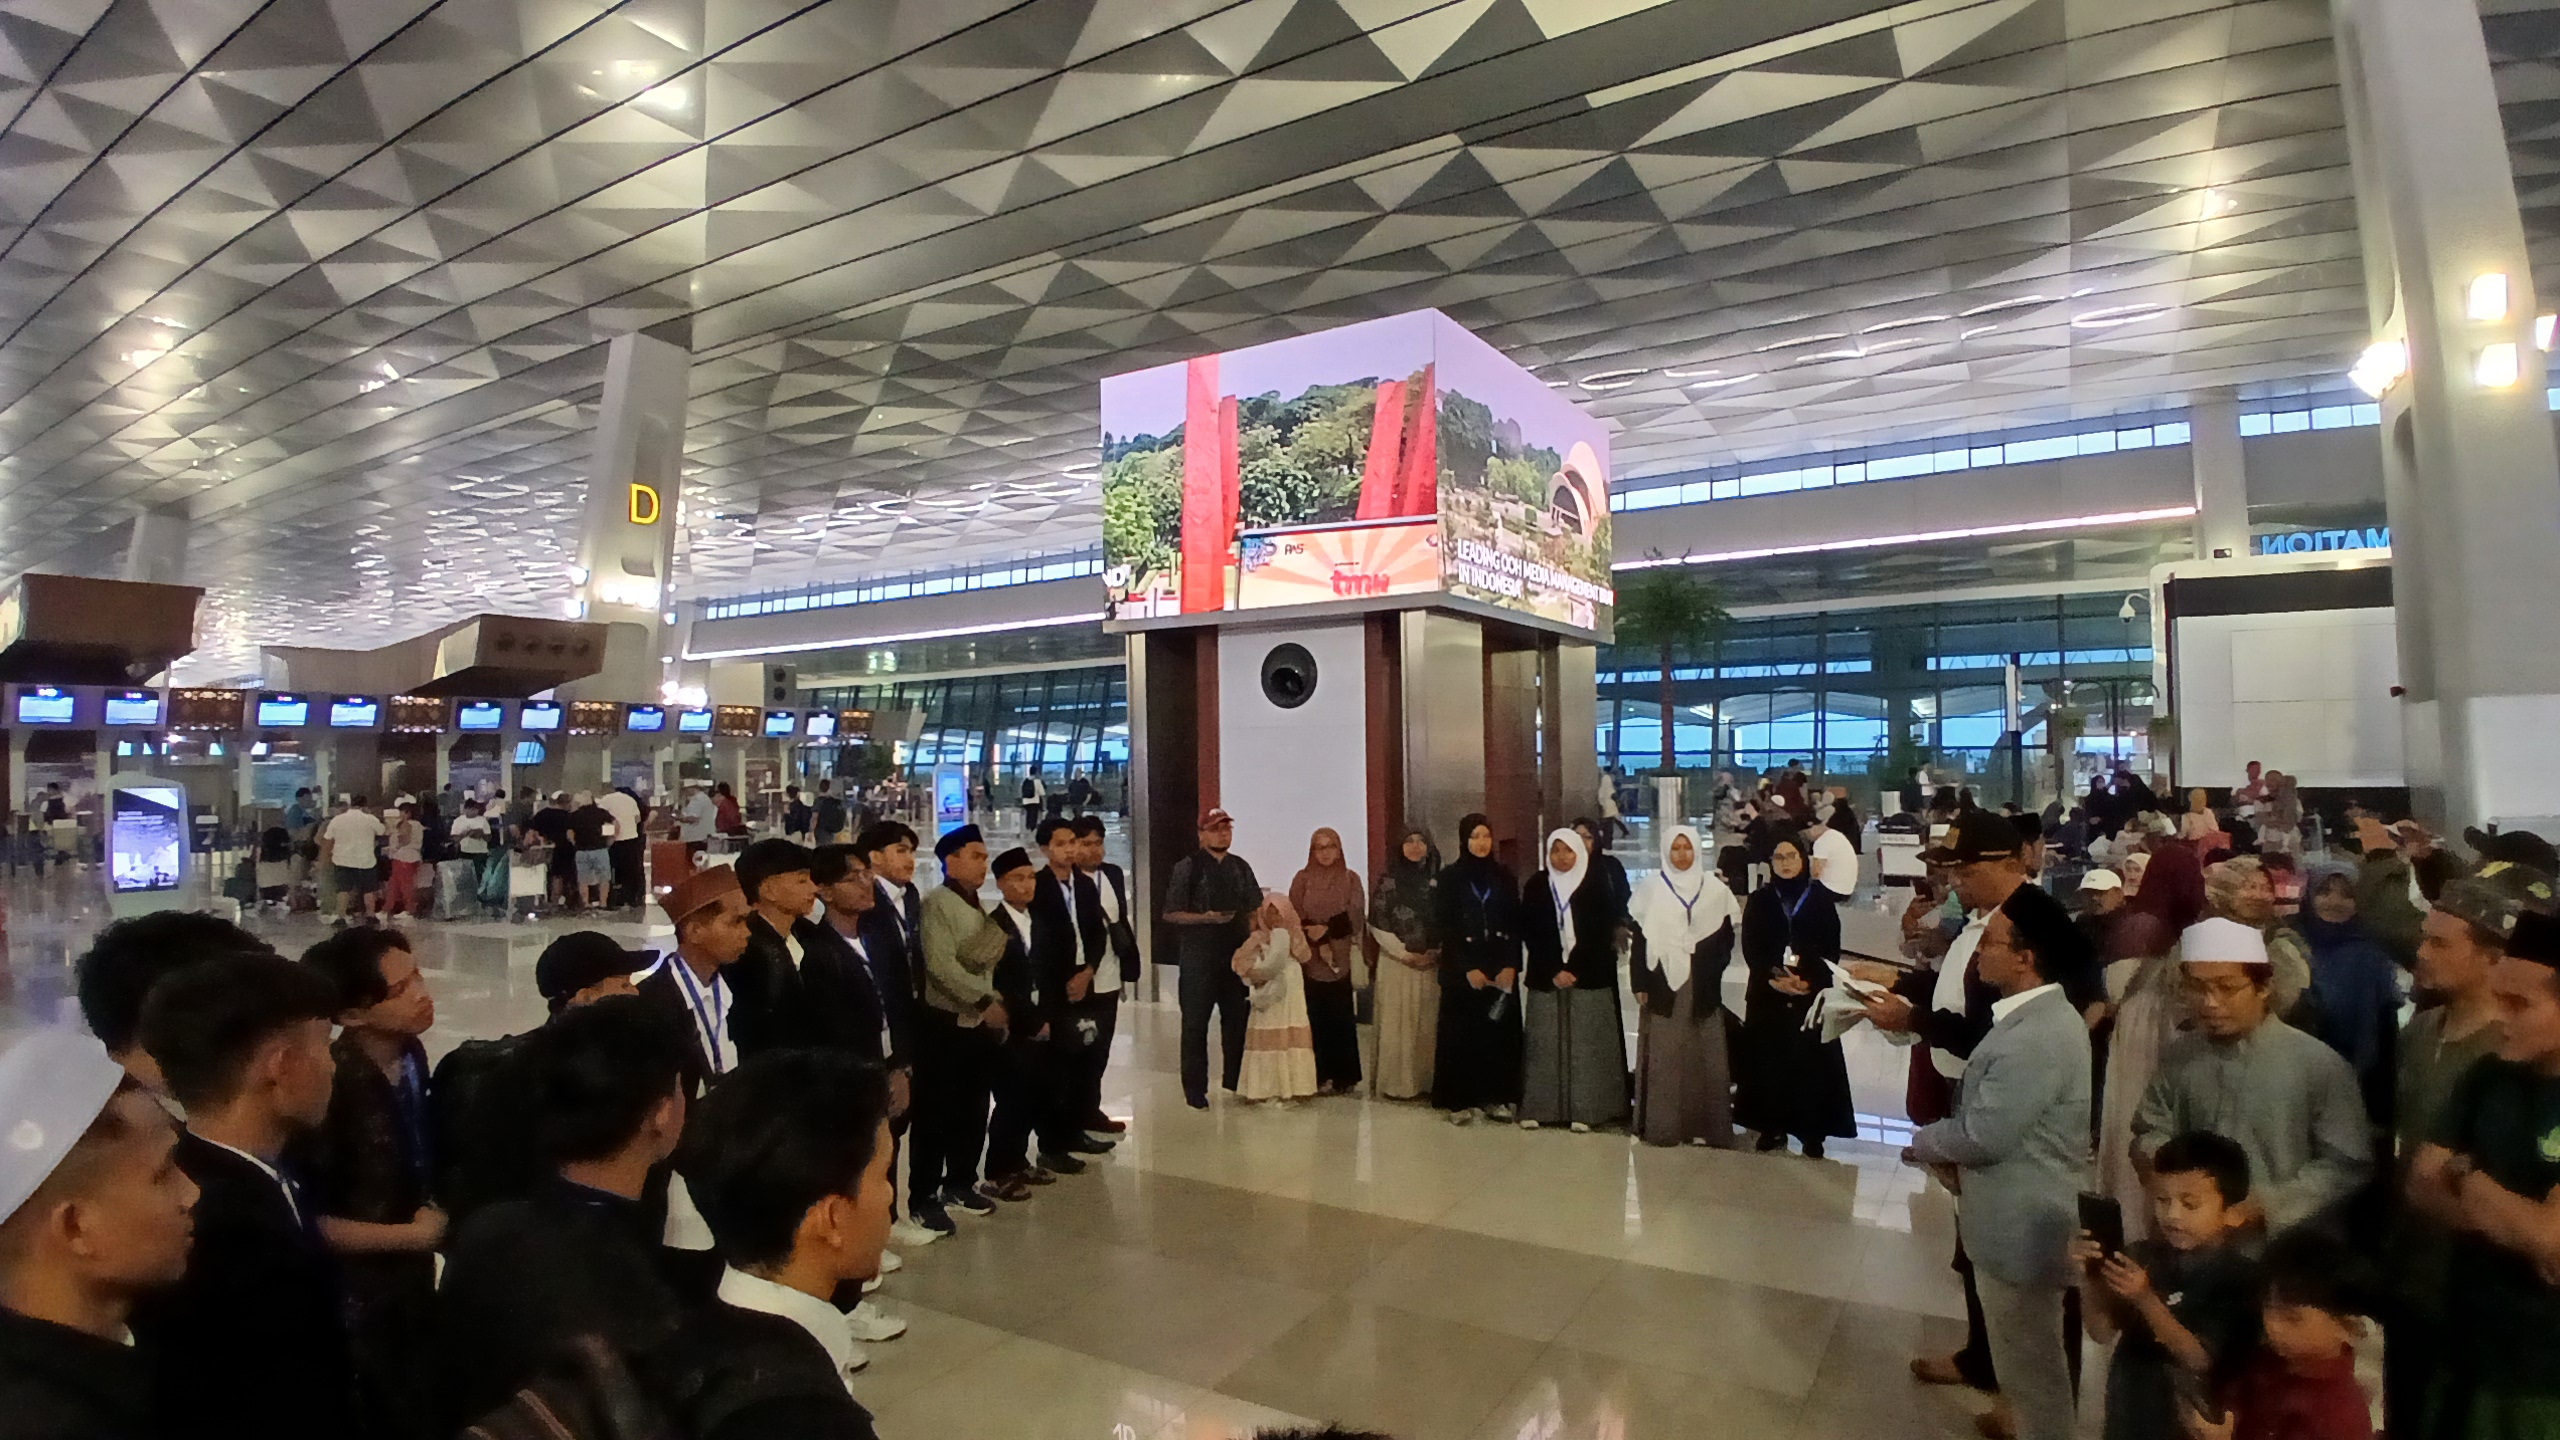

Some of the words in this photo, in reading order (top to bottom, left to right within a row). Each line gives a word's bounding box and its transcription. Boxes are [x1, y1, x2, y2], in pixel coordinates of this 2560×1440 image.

[630, 483, 659, 524] D
[1457, 538, 1501, 570] LEADING
[1523, 561, 1550, 587] MEDIA
[1551, 568, 1599, 601] MANAGEMENT
[1471, 567, 1523, 598] INDONESIA
